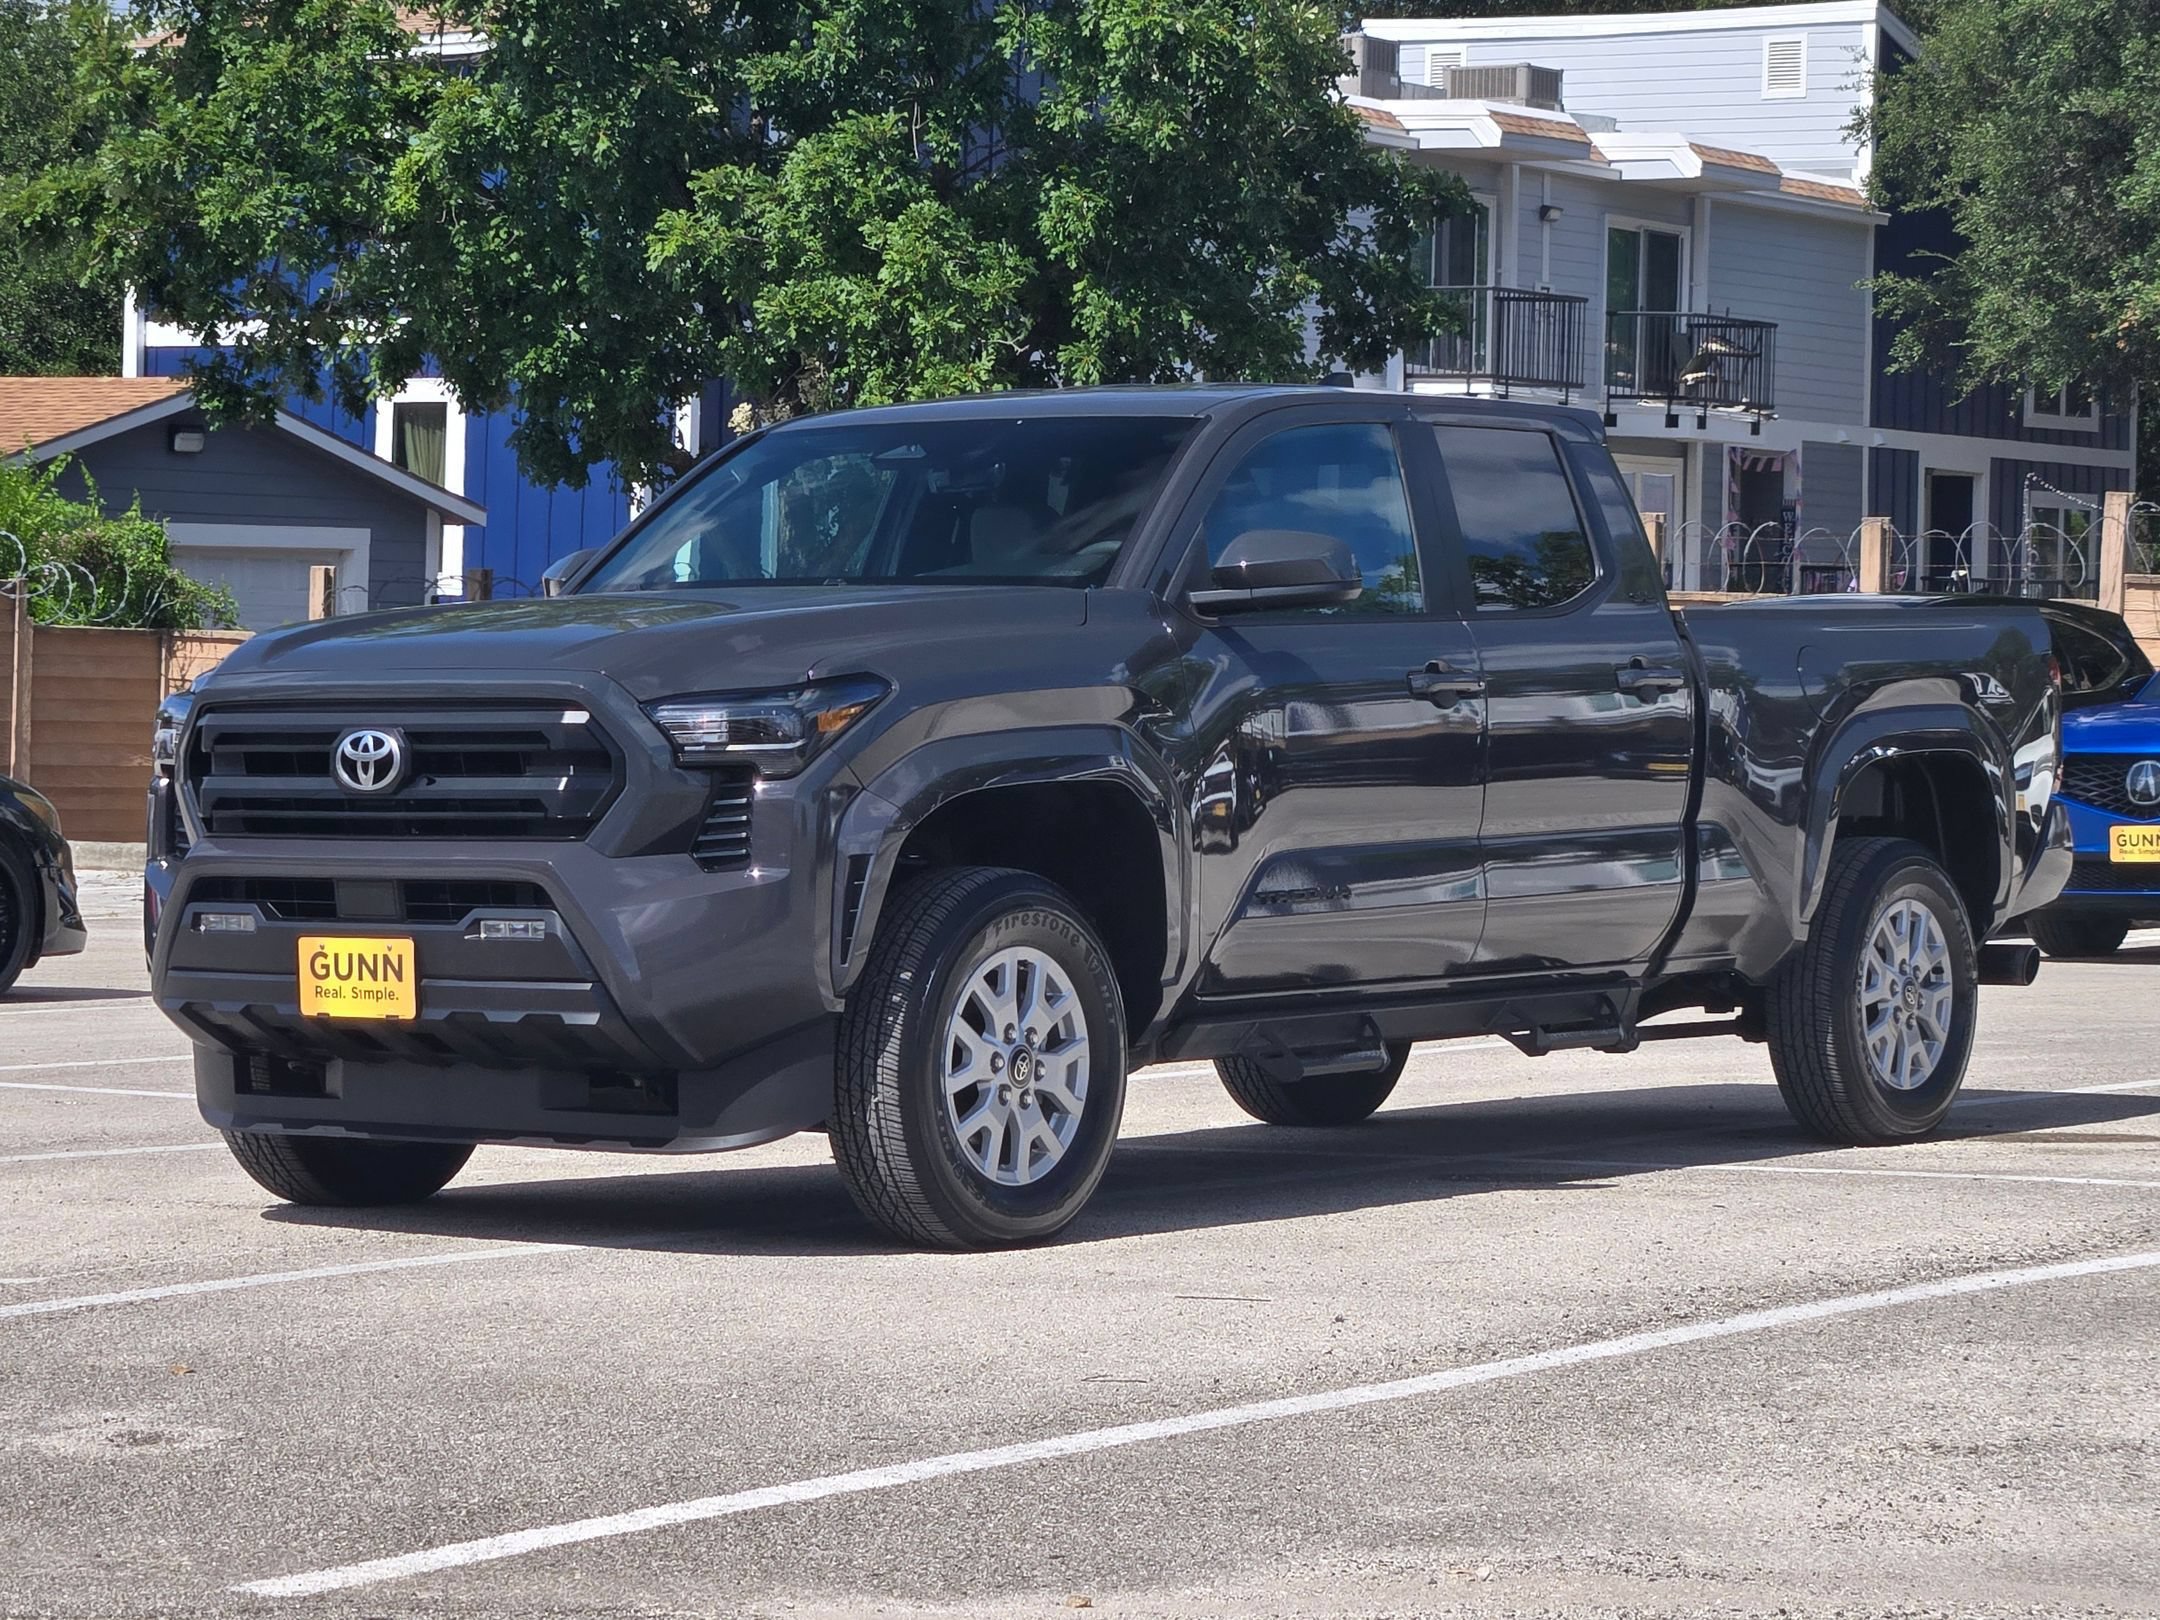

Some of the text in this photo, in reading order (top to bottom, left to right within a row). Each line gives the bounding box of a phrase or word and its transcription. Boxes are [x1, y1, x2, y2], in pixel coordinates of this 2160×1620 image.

[992, 912, 1080, 947] Firestone
[309, 951, 403, 983] GUNN
[315, 985, 399, 1003] Real. Simple.
